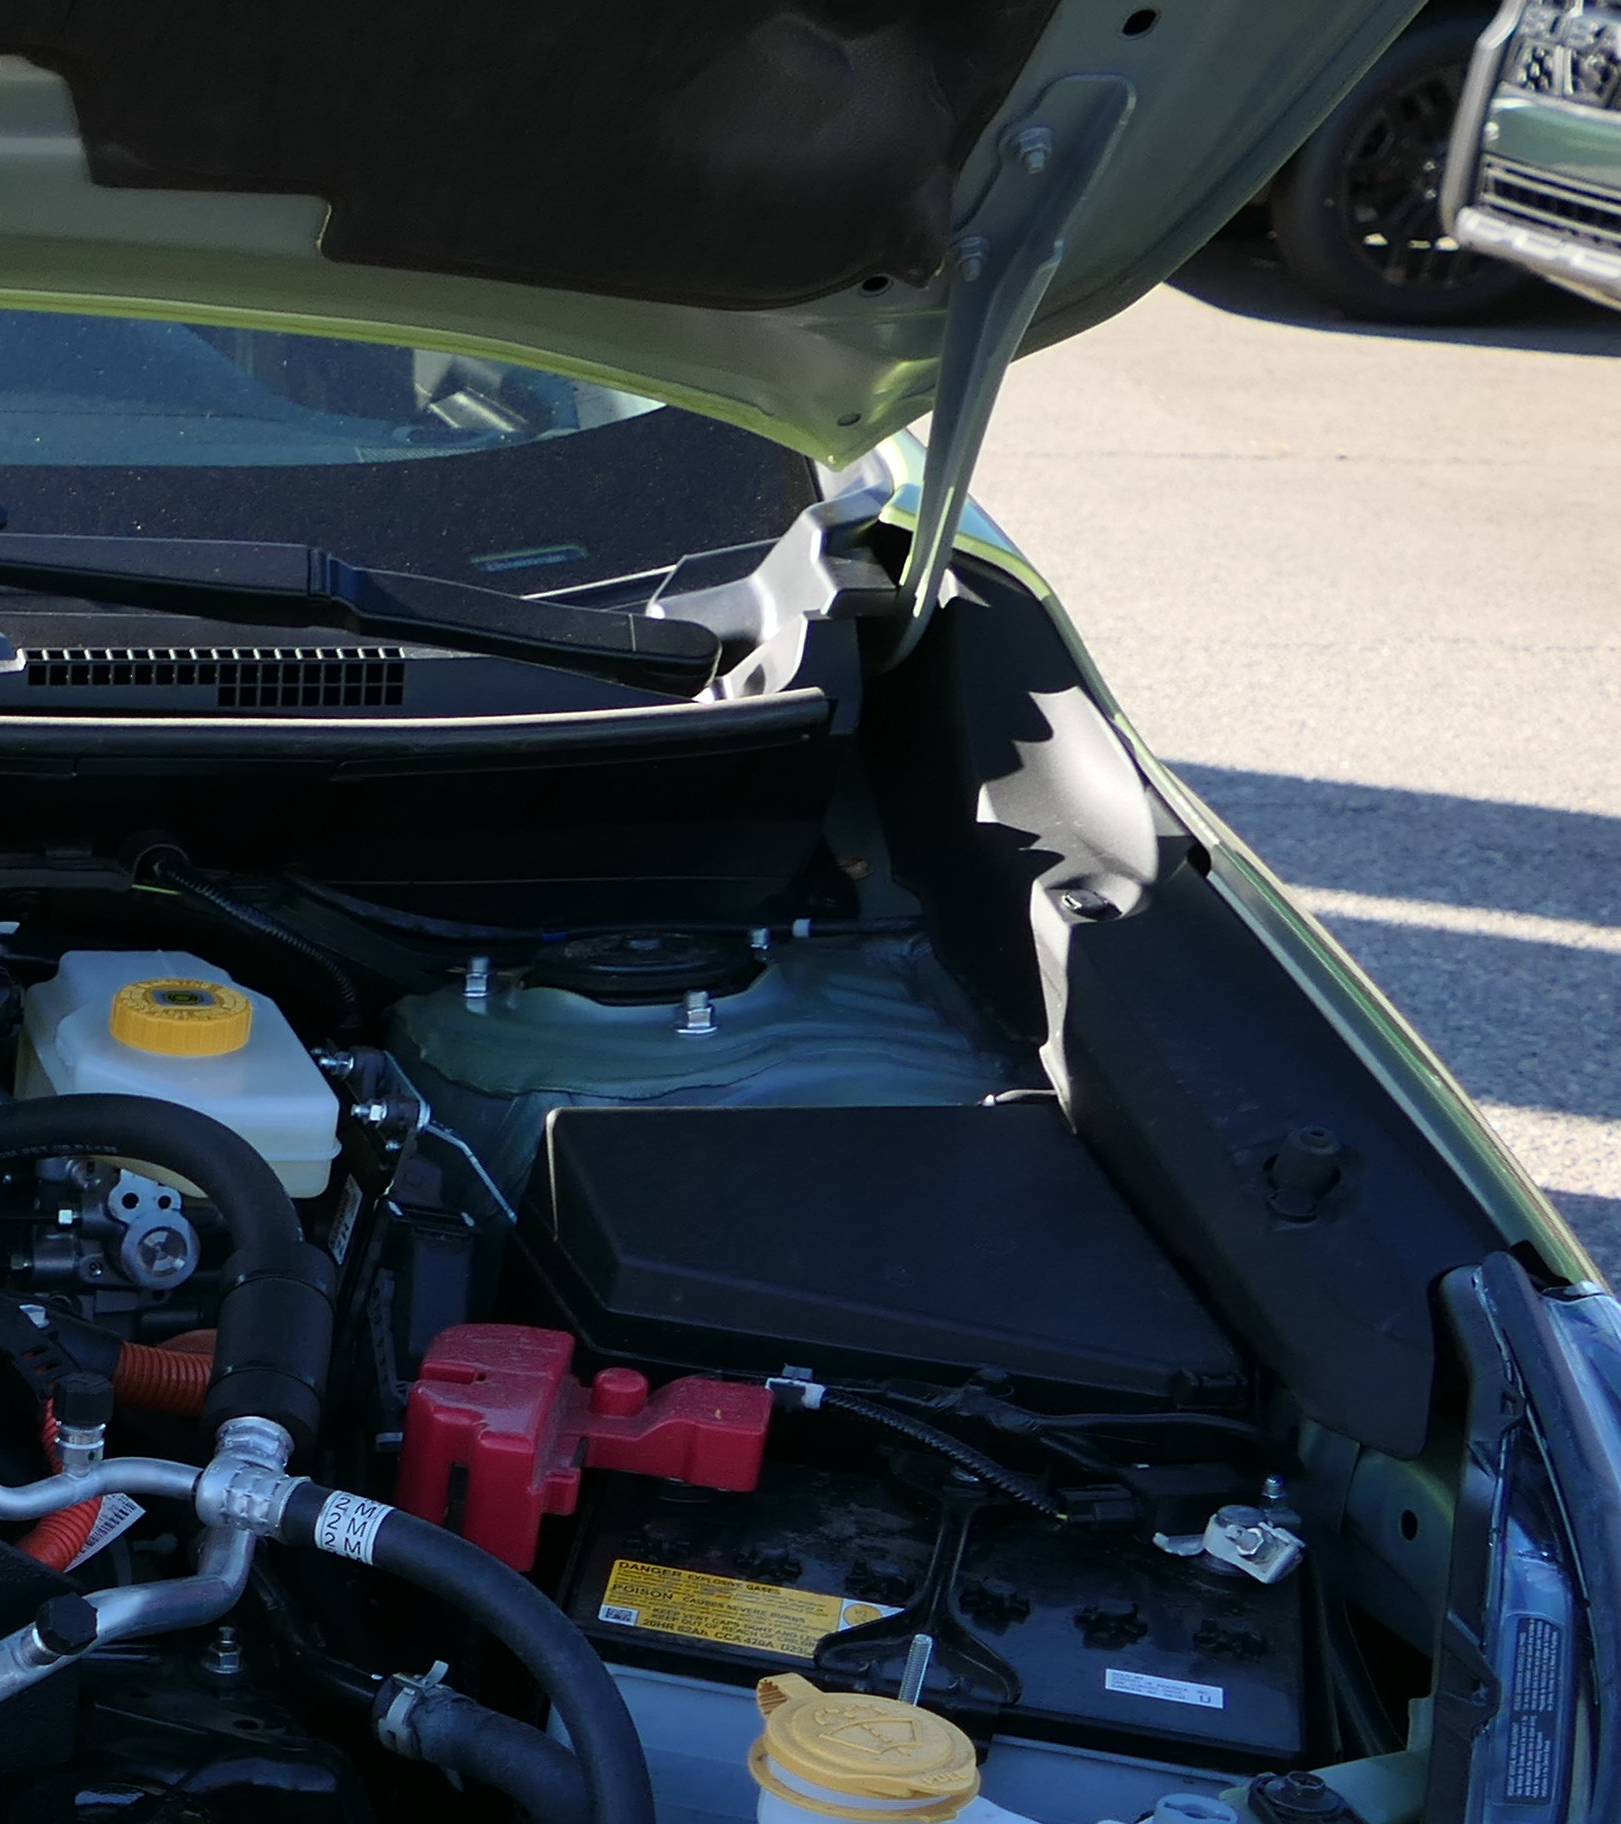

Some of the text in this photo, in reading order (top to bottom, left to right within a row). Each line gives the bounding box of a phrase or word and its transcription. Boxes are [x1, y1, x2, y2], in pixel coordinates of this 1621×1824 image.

[335, 1497, 377, 1518] 2 M
[327, 1512, 368, 1537] 2 M
[324, 1532, 361, 1555] 2 M
[619, 1561, 682, 1578] DANGER
[687, 1573, 744, 1588] EXPLOSIVE
[612, 1583, 674, 1600] POISON
